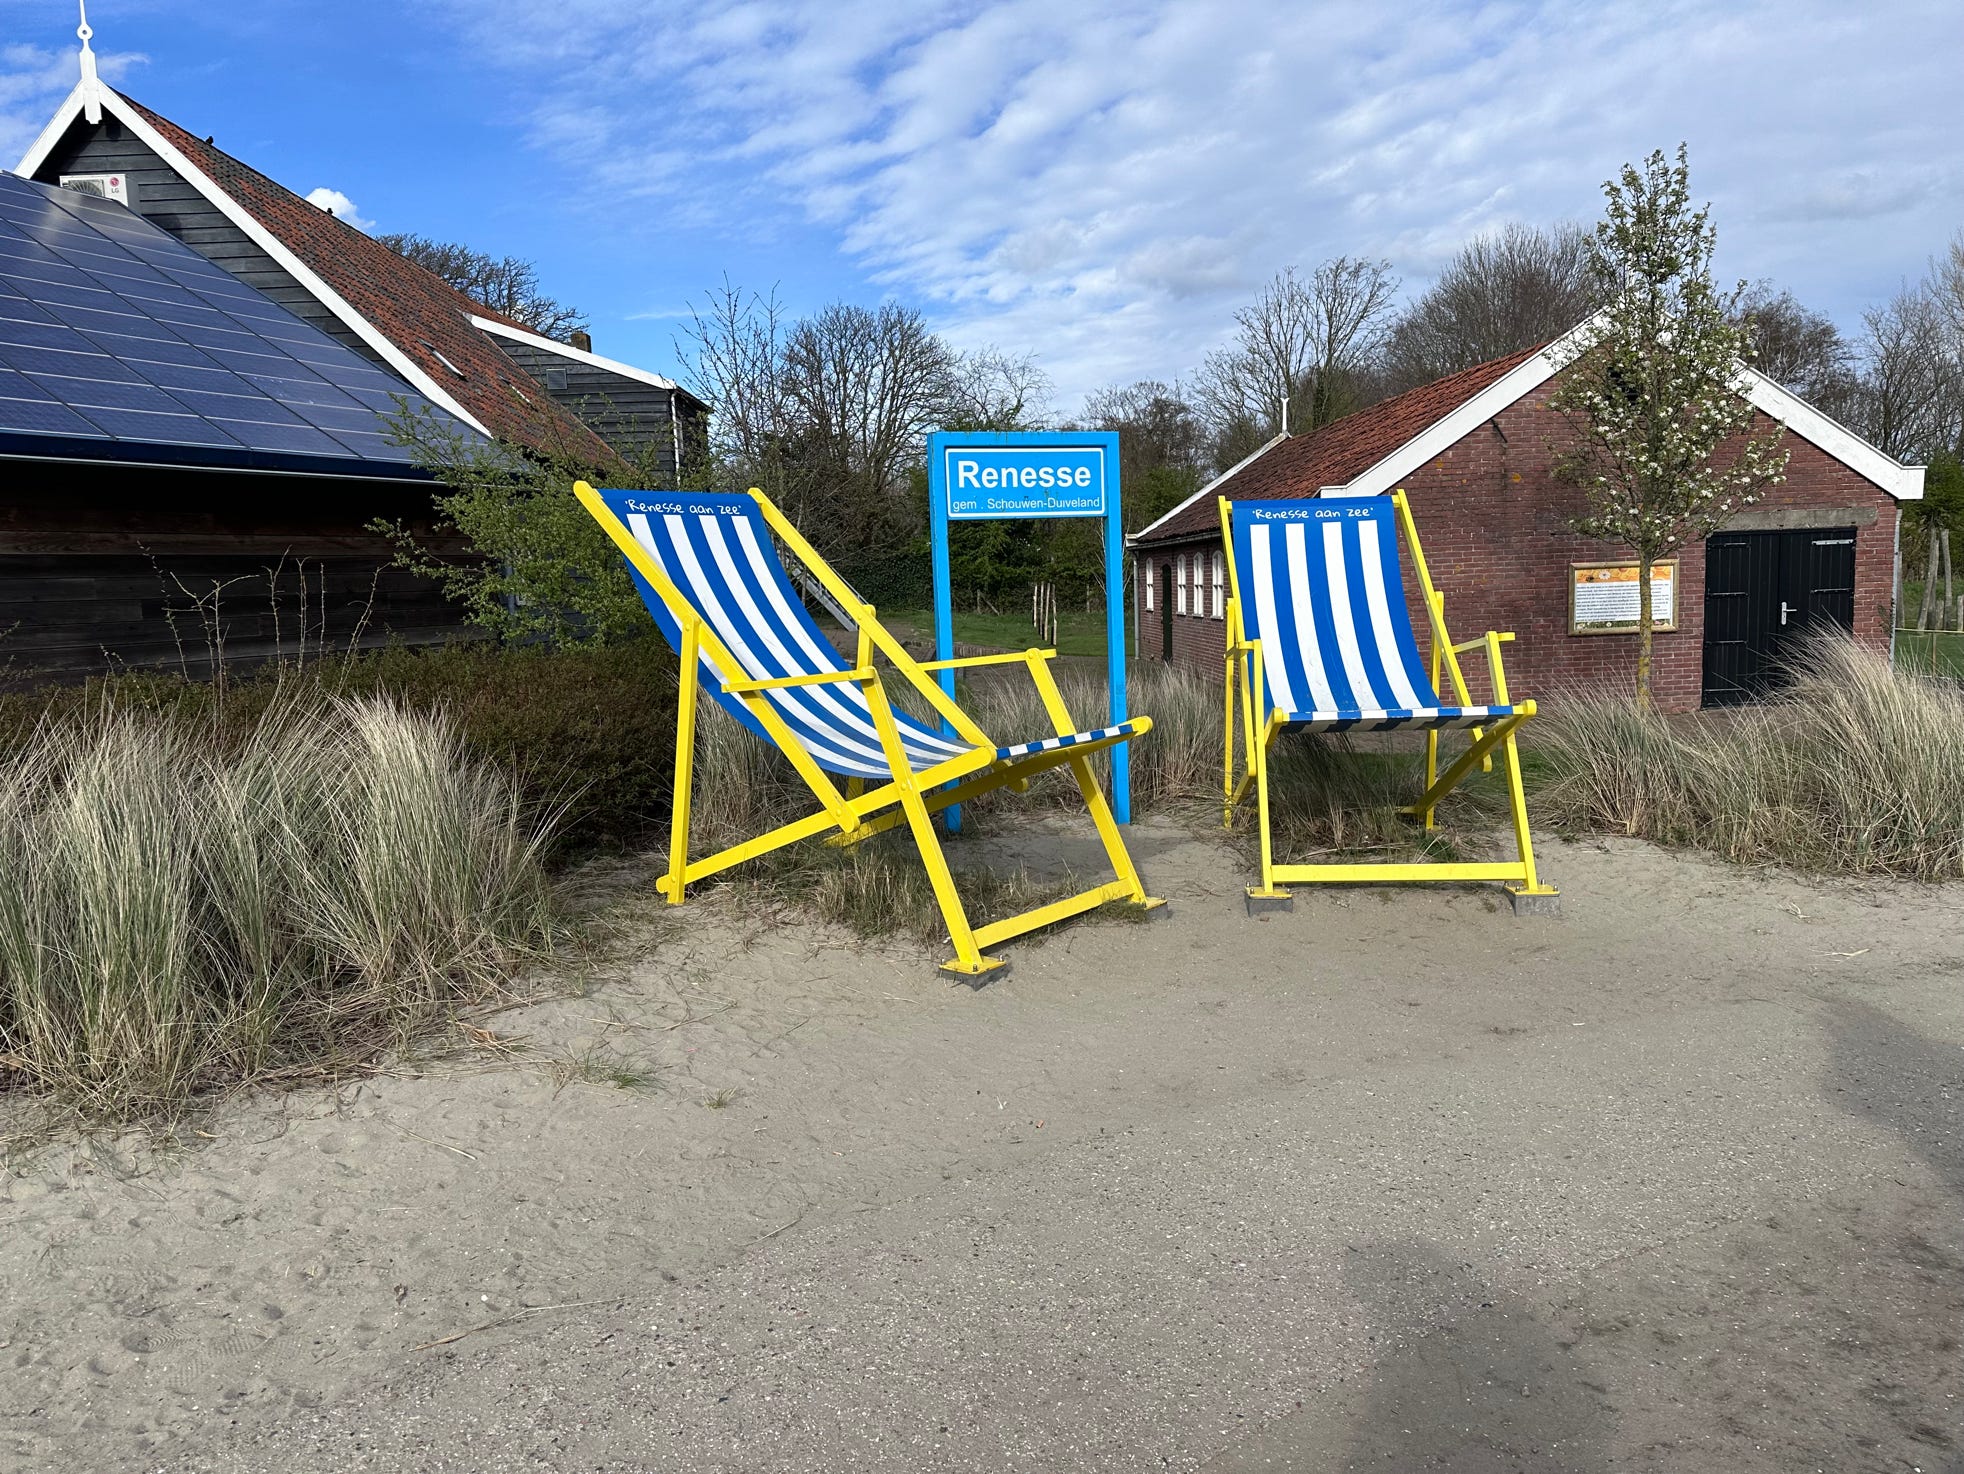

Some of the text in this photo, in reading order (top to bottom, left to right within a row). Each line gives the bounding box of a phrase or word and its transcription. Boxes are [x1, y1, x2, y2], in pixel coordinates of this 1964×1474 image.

[957, 460, 1091, 489] Renesse
[987, 497, 1100, 510] Schouwen-Duiveland
[689, 505, 714, 514] aan
[1315, 509, 1341, 518] aan
